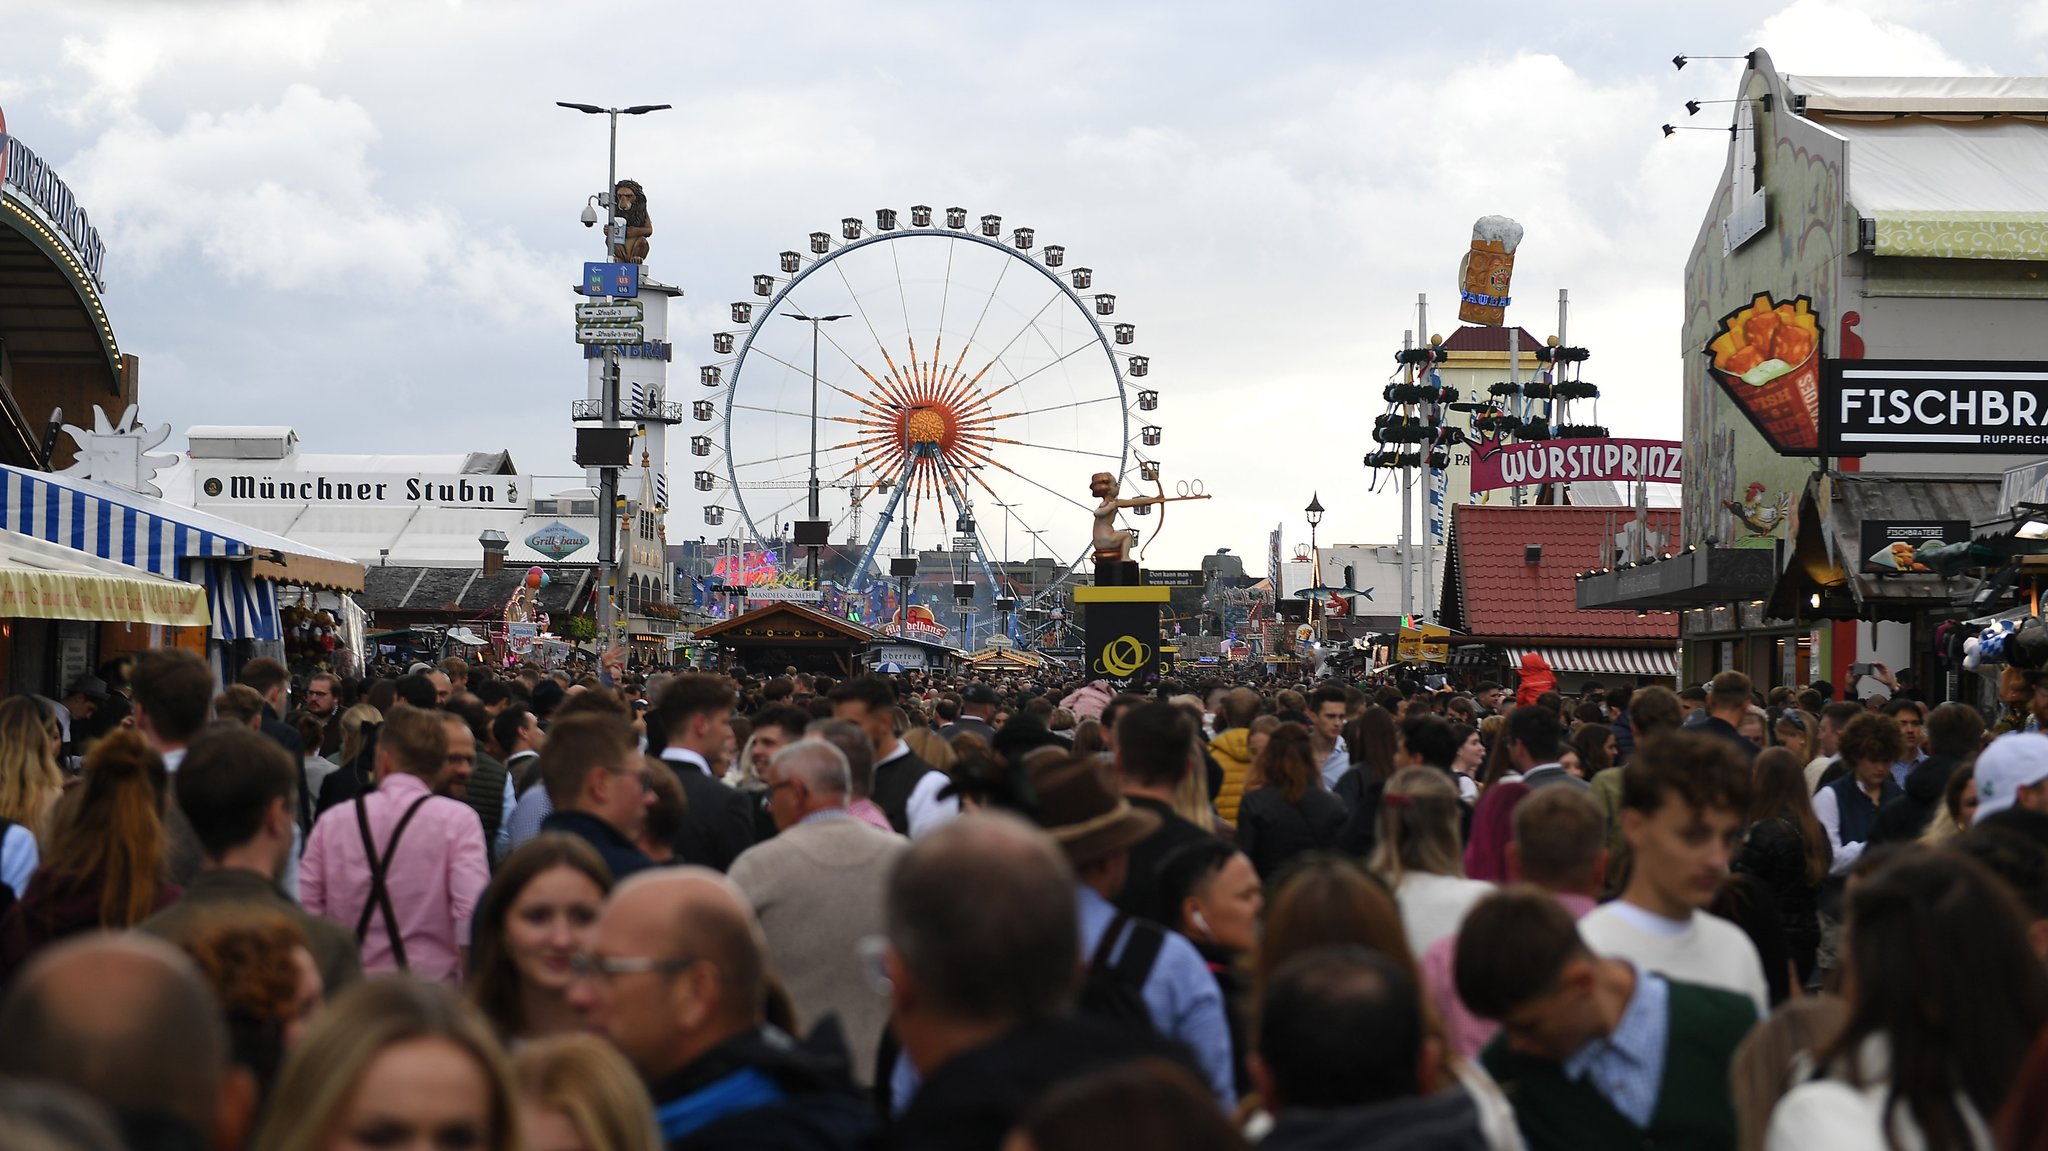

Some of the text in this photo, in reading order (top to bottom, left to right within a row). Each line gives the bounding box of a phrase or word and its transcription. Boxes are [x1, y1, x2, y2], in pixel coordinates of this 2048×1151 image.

[6, 136, 107, 294] BRÄUROSL
[1840, 388, 2048, 427] FISCHBR
[1500, 443, 1683, 484] WÜRSTLPRINZ
[230, 475, 495, 502] Münchner Stubn
[1886, 528, 1944, 537] FISCHBRATEREI
[885, 621, 941, 636] Madelhans
